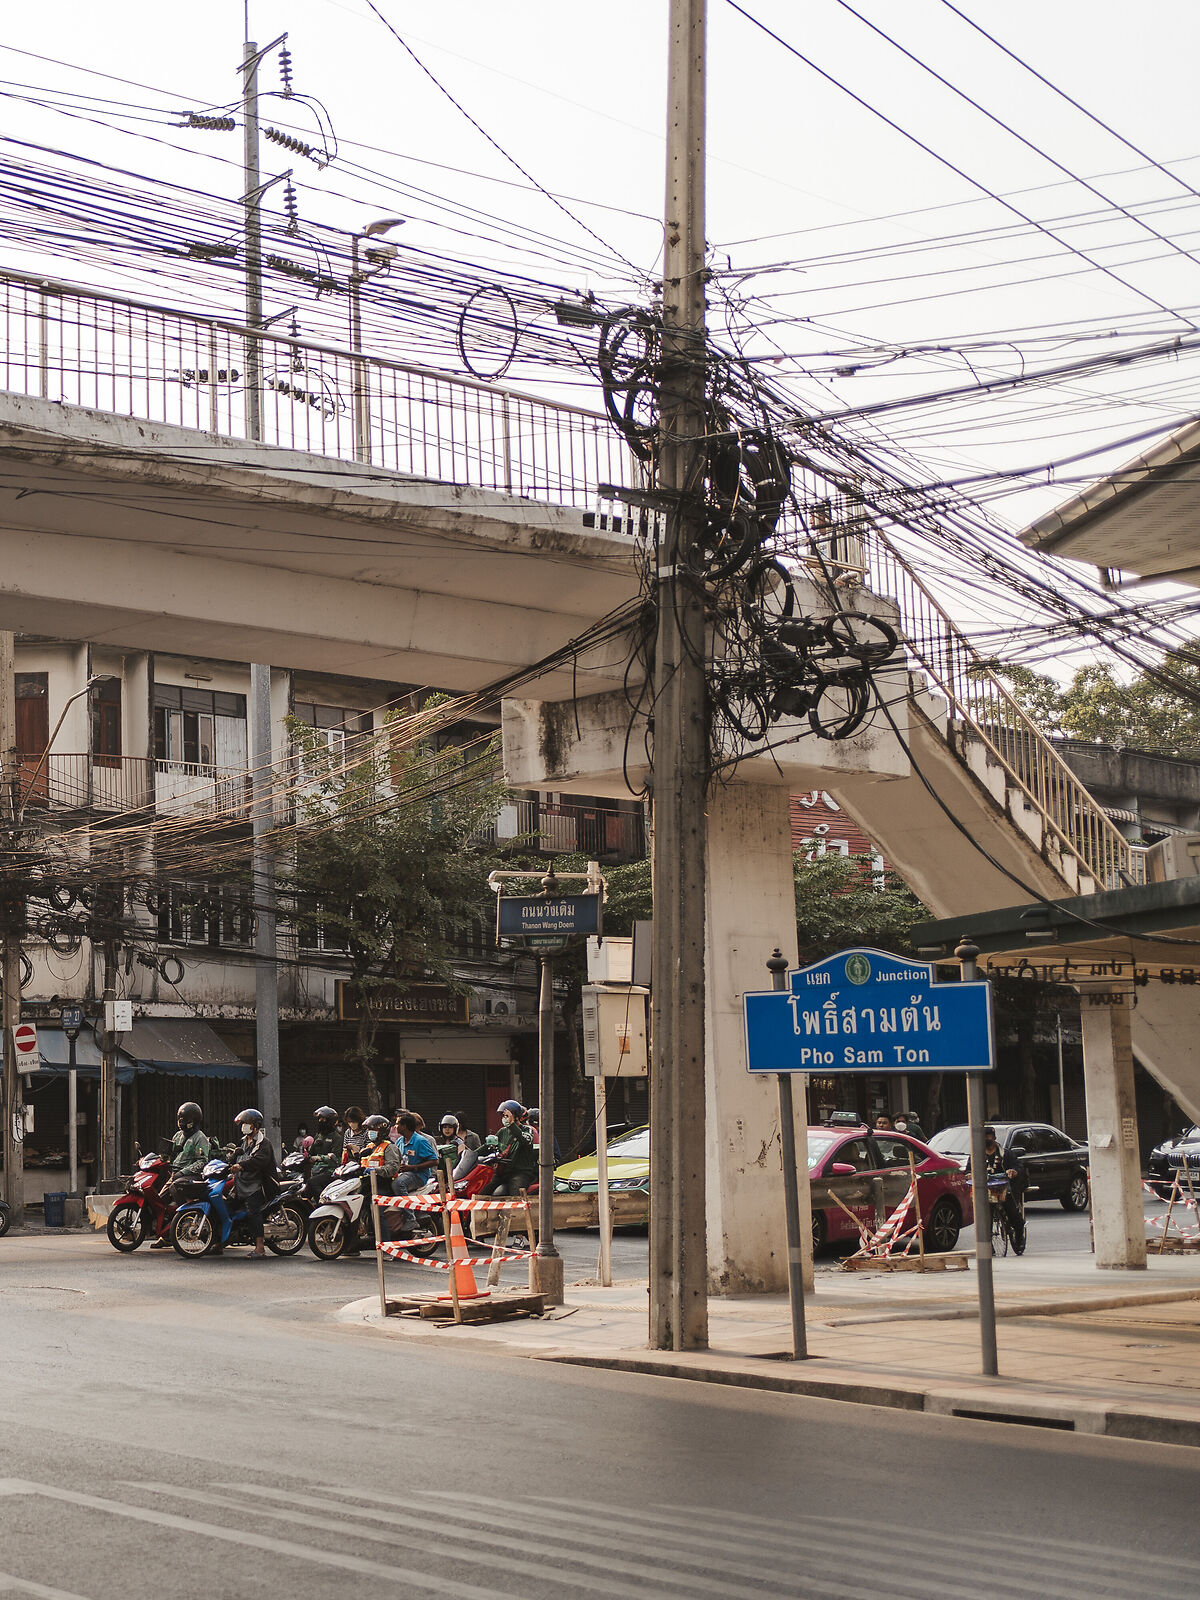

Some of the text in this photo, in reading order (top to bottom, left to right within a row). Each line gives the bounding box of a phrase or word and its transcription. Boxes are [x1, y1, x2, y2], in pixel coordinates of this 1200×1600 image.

[521, 900, 575, 918] ถนนวังเดิม
[542, 921, 558, 930] Wang
[806, 972, 831, 985] แยก
[876, 970, 927, 982] Junction
[787, 992, 941, 1035] โพธิ์สามต้น
[801, 1045, 930, 1064] Pho Sam Ton
